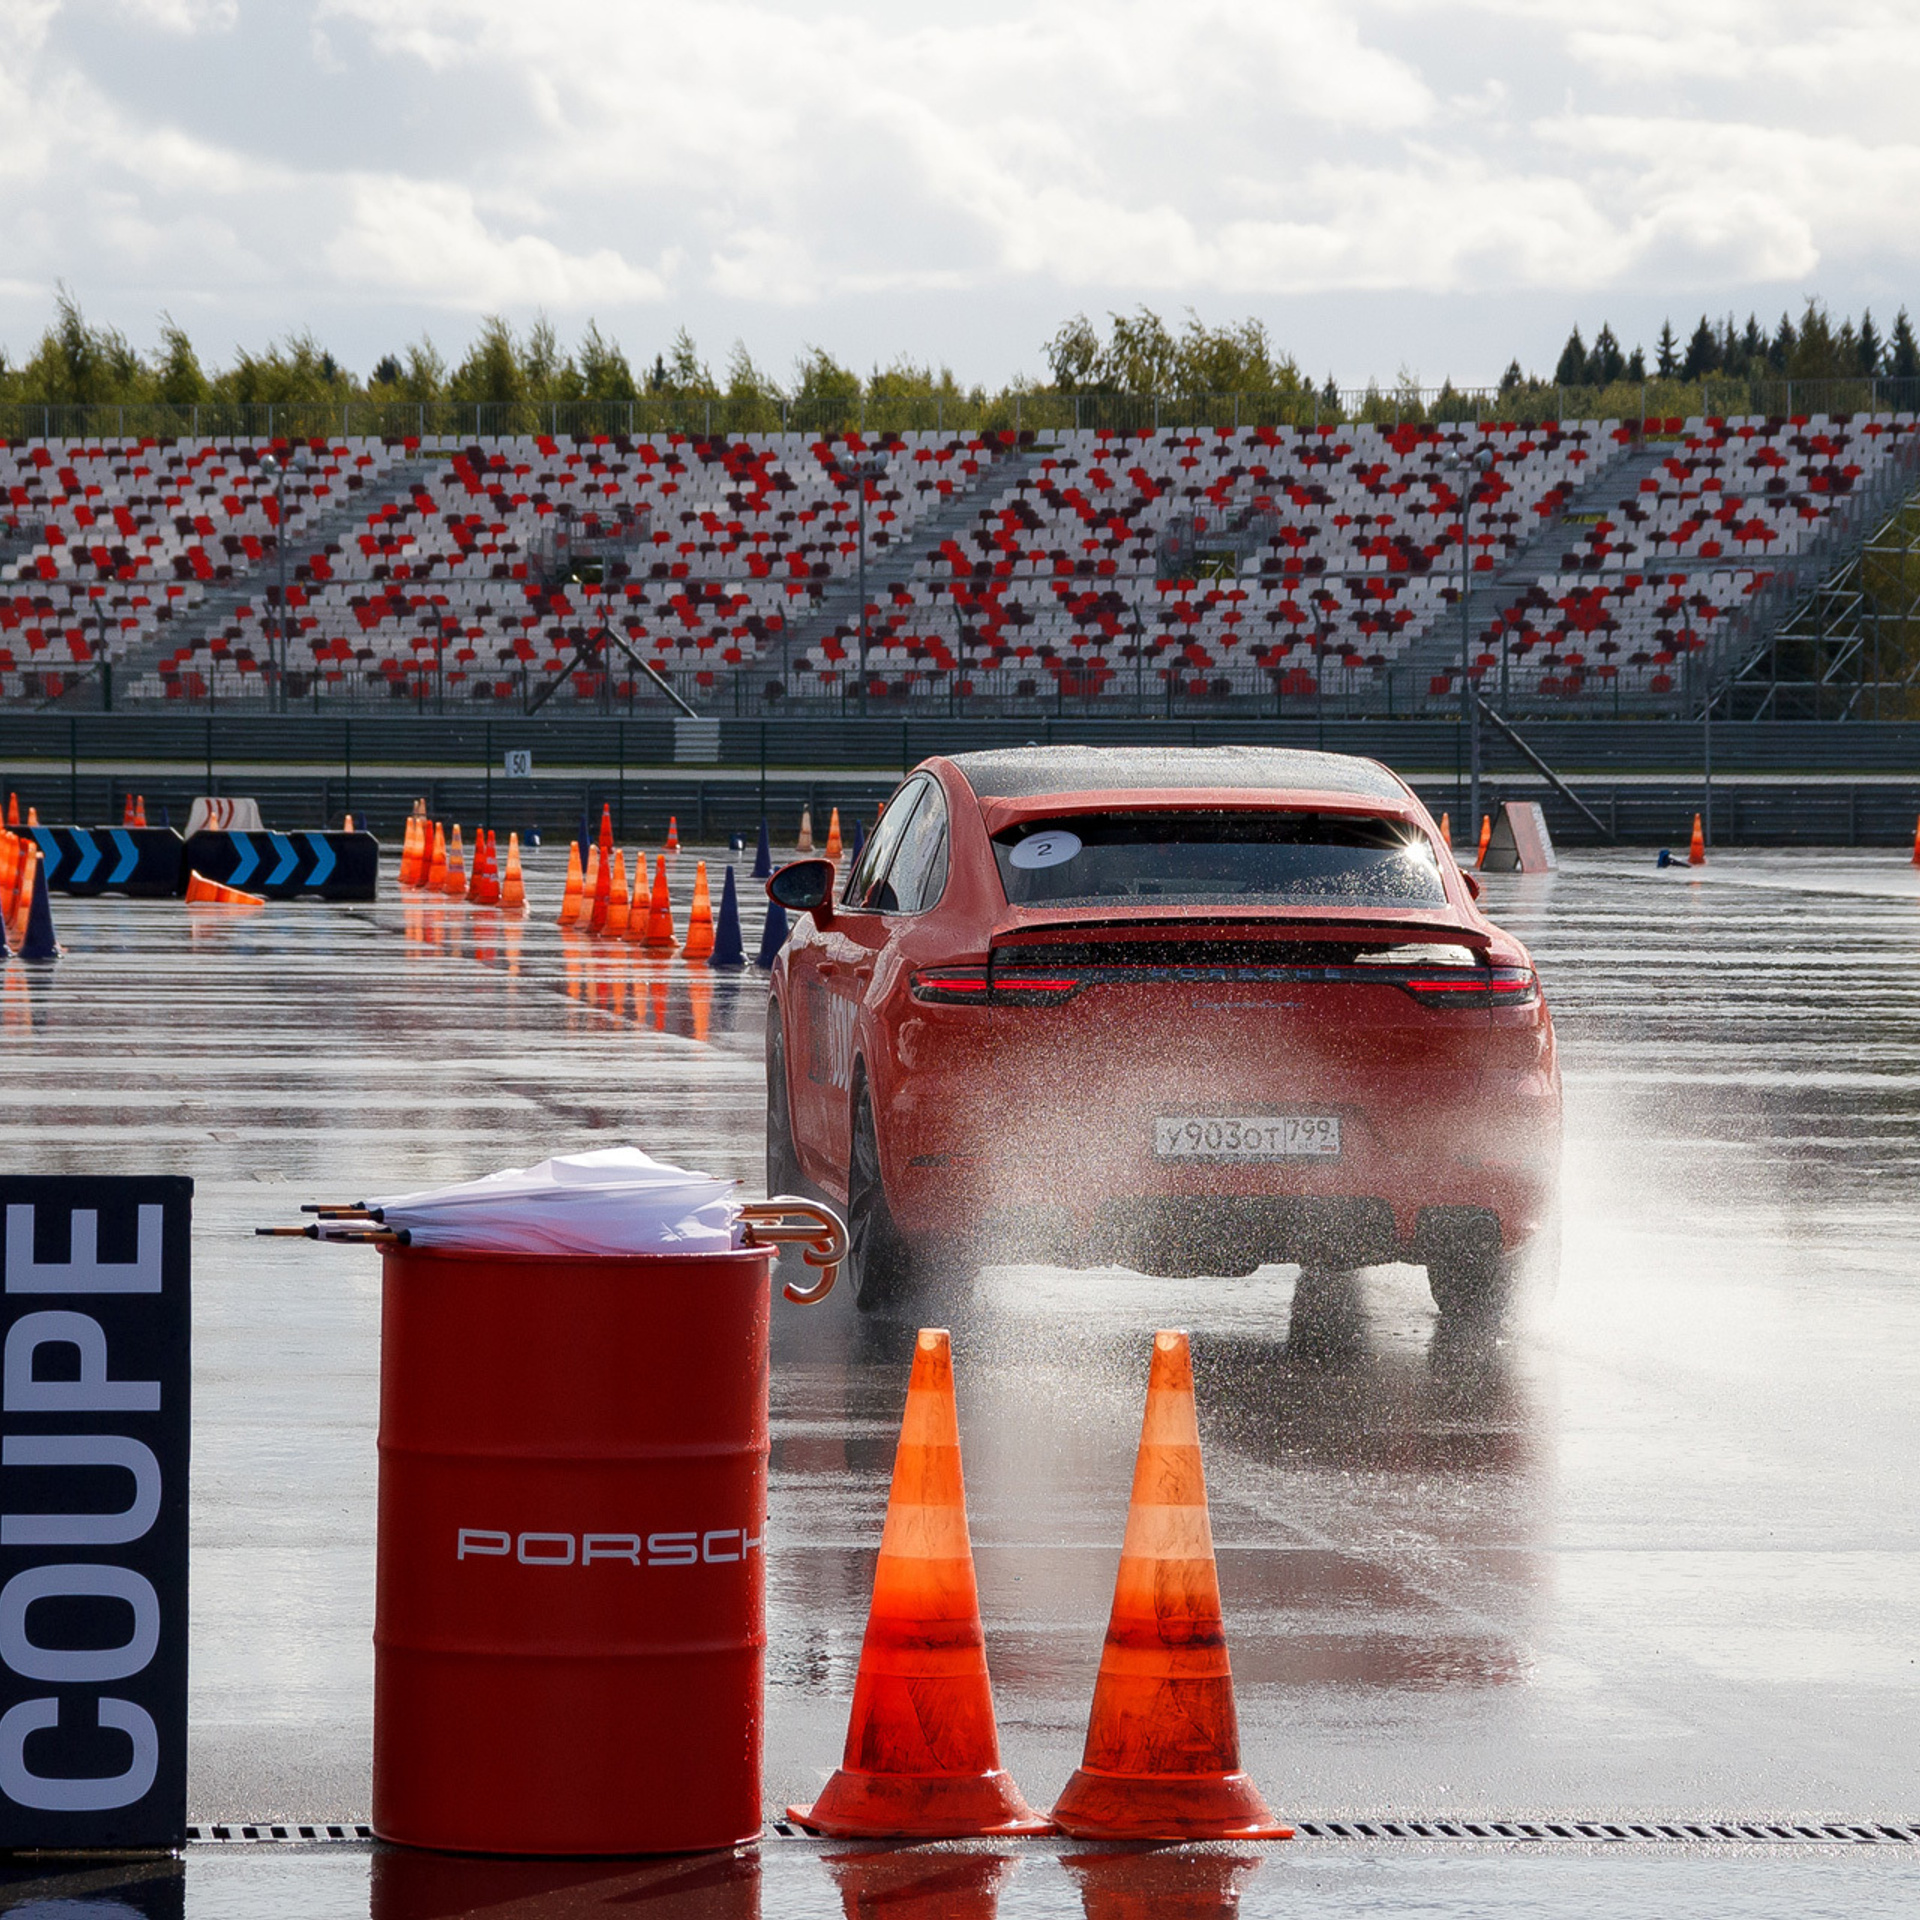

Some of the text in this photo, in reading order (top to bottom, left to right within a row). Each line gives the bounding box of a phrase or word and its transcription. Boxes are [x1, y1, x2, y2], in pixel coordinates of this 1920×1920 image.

[513, 754, 527, 774] 50
[1037, 843, 1053, 856] 2
[1287, 1119, 1331, 1141] 799
[0, 1204, 163, 1811] COUPE
[457, 1524, 766, 1566] PORSCH
